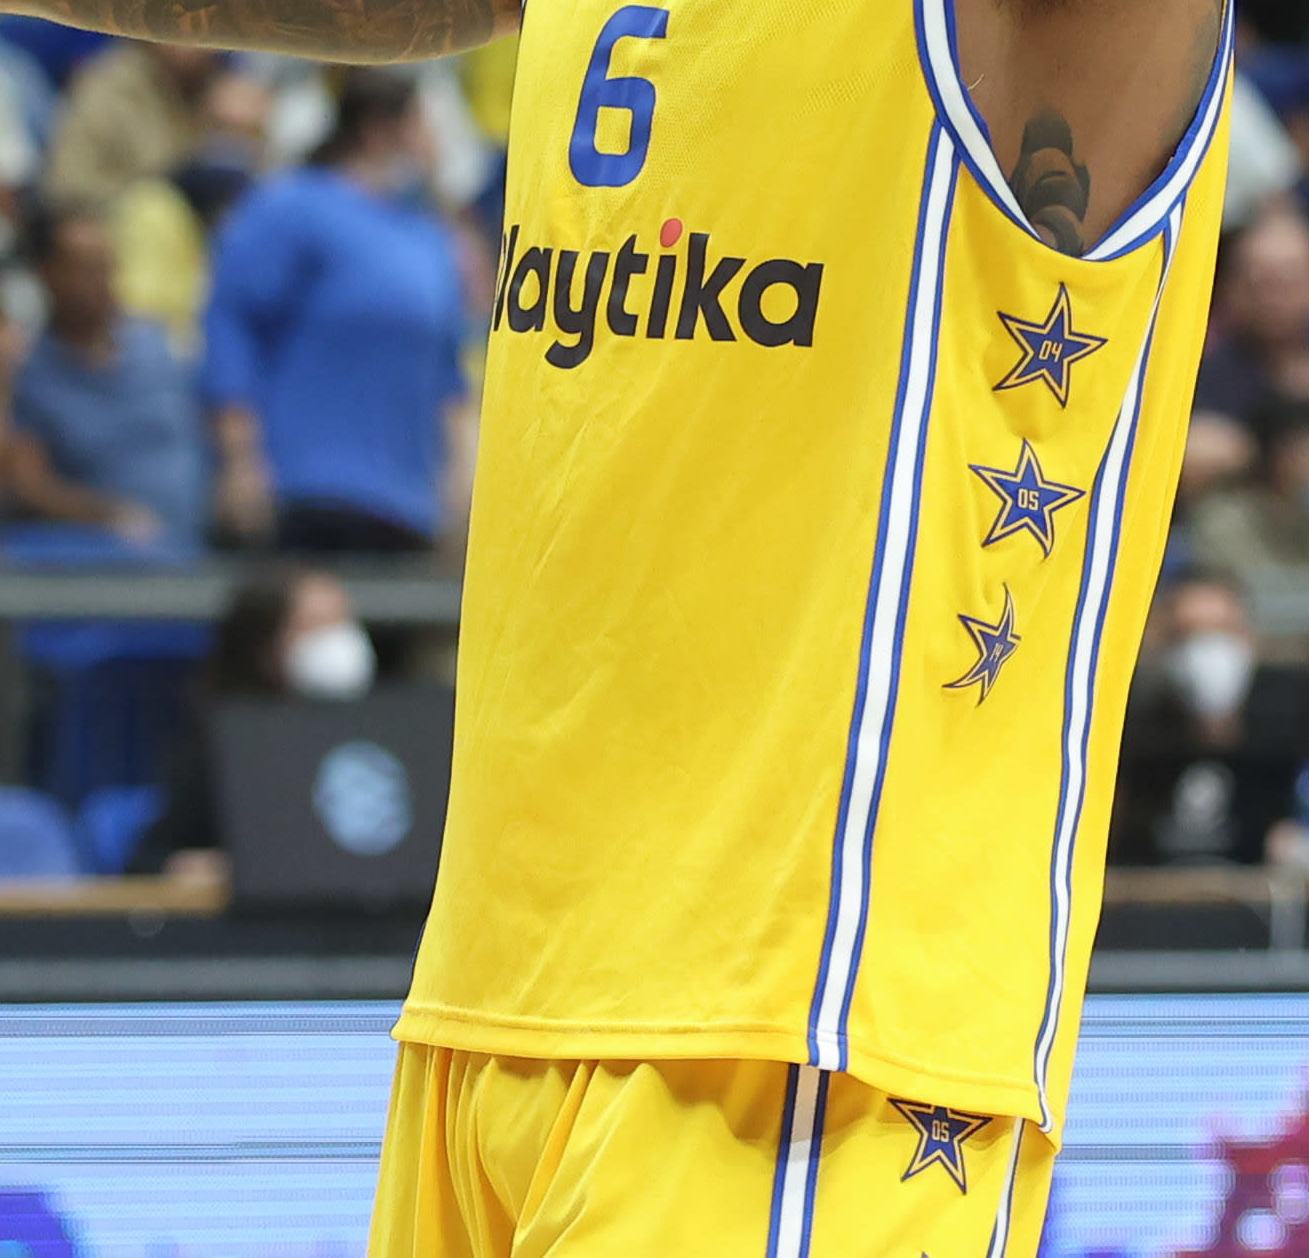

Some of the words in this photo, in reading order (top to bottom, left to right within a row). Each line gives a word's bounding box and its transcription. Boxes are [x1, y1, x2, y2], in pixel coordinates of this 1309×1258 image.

[569, 5, 670, 187] 6
[493, 218, 824, 369] laytika
[1039, 340, 1062, 363] 04
[1018, 488, 1040, 511] 05
[931, 1119, 950, 1143] 05
